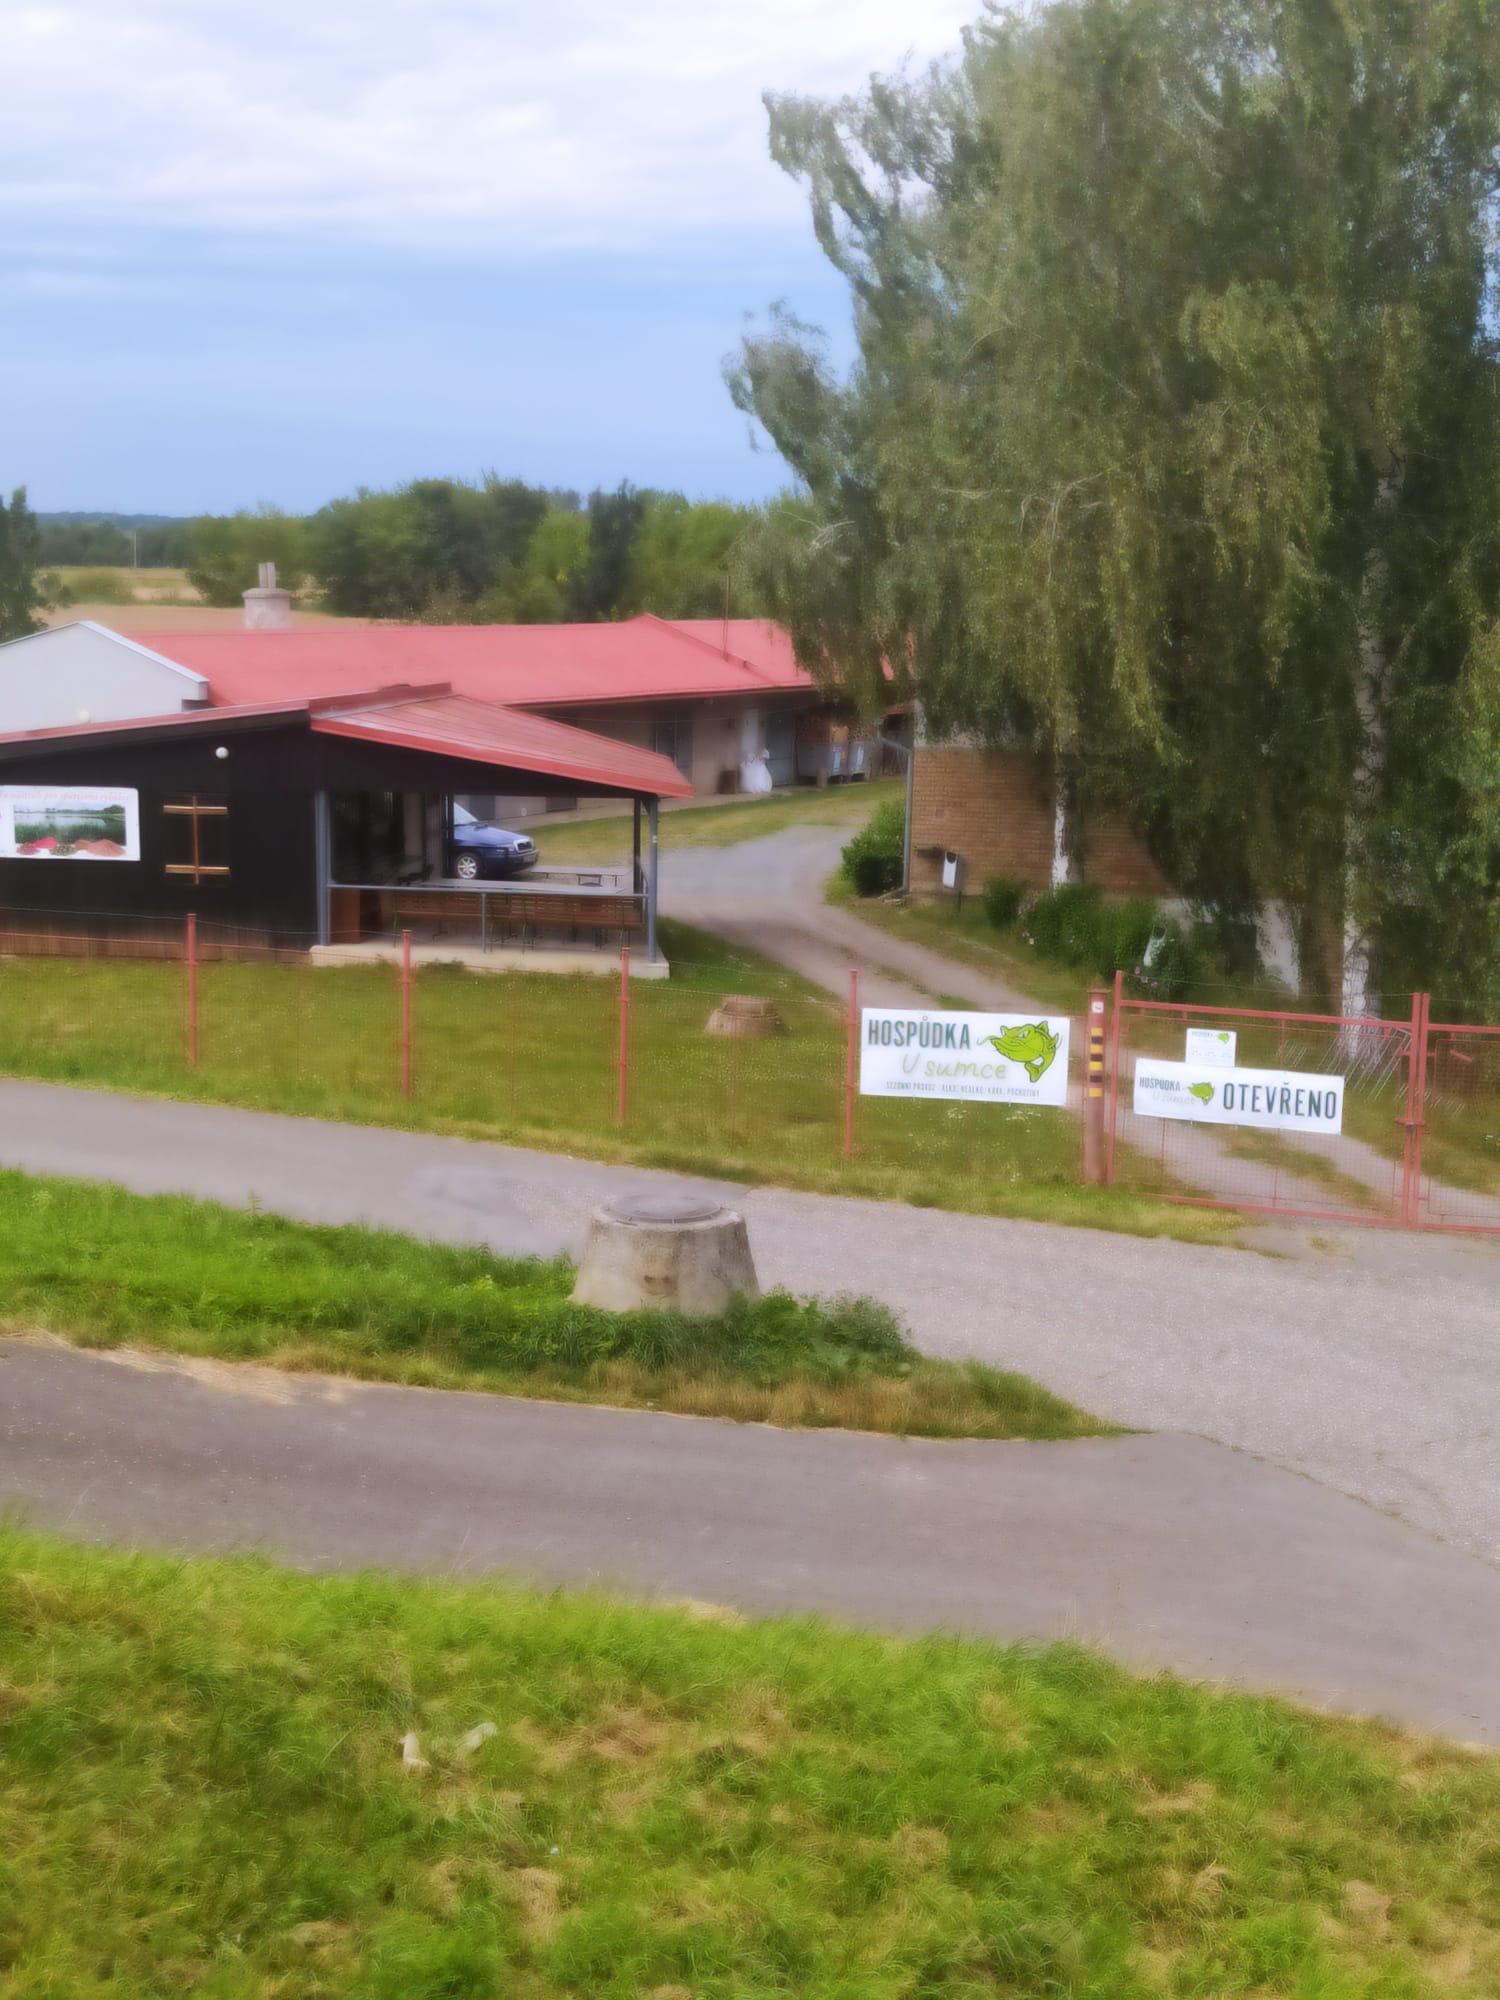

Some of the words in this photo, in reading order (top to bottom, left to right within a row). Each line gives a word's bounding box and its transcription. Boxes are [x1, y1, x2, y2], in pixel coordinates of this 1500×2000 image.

[868, 1015, 971, 1049] HOSPŮDKA
[902, 1053, 921, 1074] U
[924, 1059, 1008, 1080] sumce
[1223, 1081, 1337, 1119] OTEVŘENO
